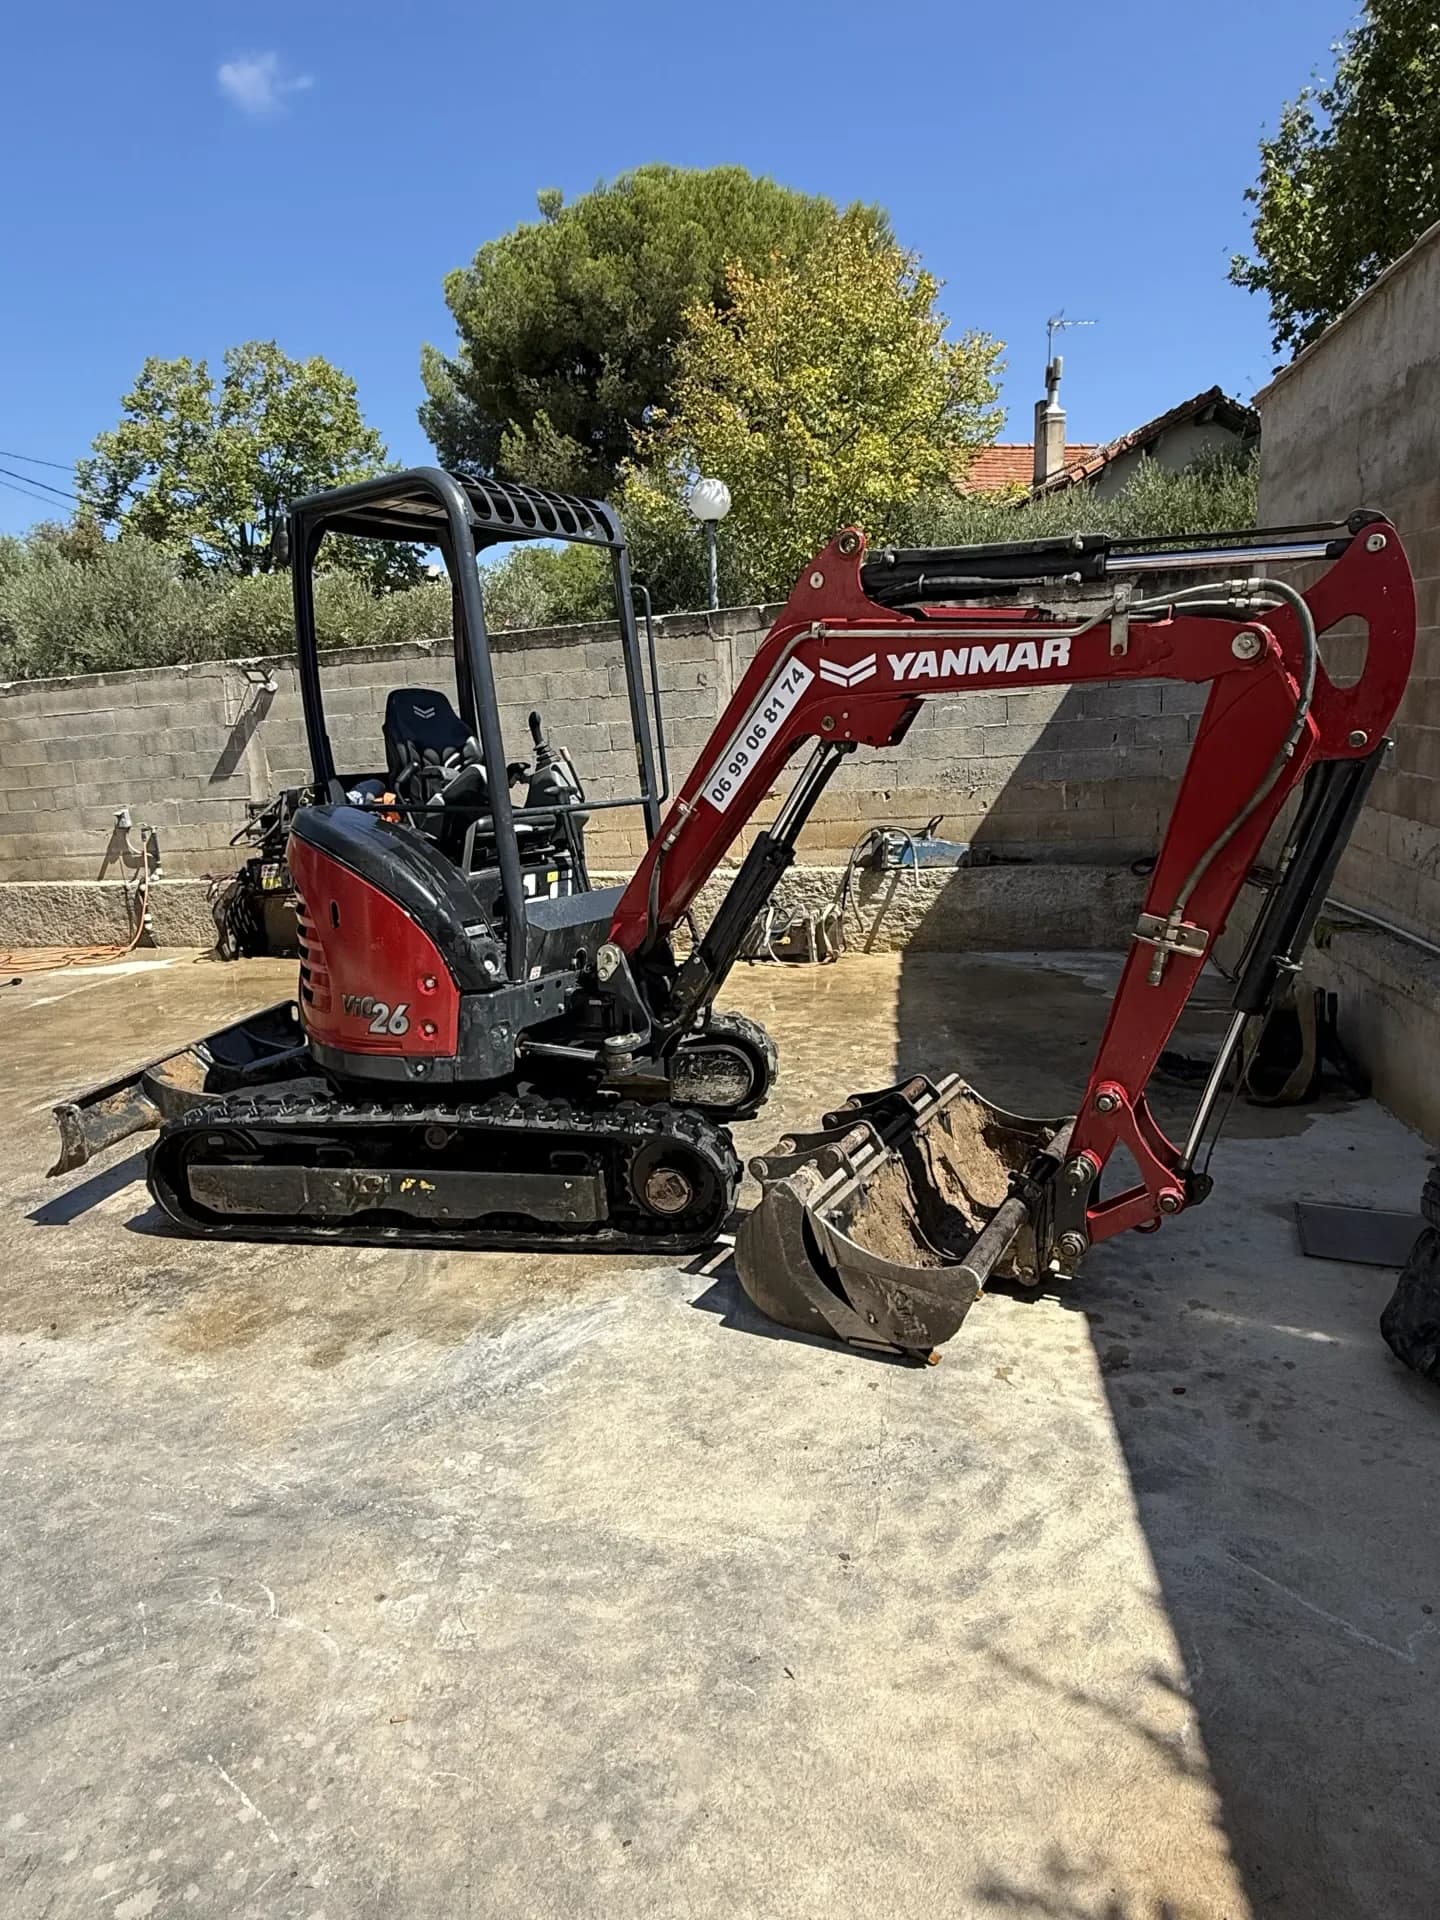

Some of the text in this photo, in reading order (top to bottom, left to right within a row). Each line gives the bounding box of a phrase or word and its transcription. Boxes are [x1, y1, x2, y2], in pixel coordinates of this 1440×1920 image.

[887, 637, 1072, 681] YANMAR
[711, 668, 805, 803] 06 99 06 81 74
